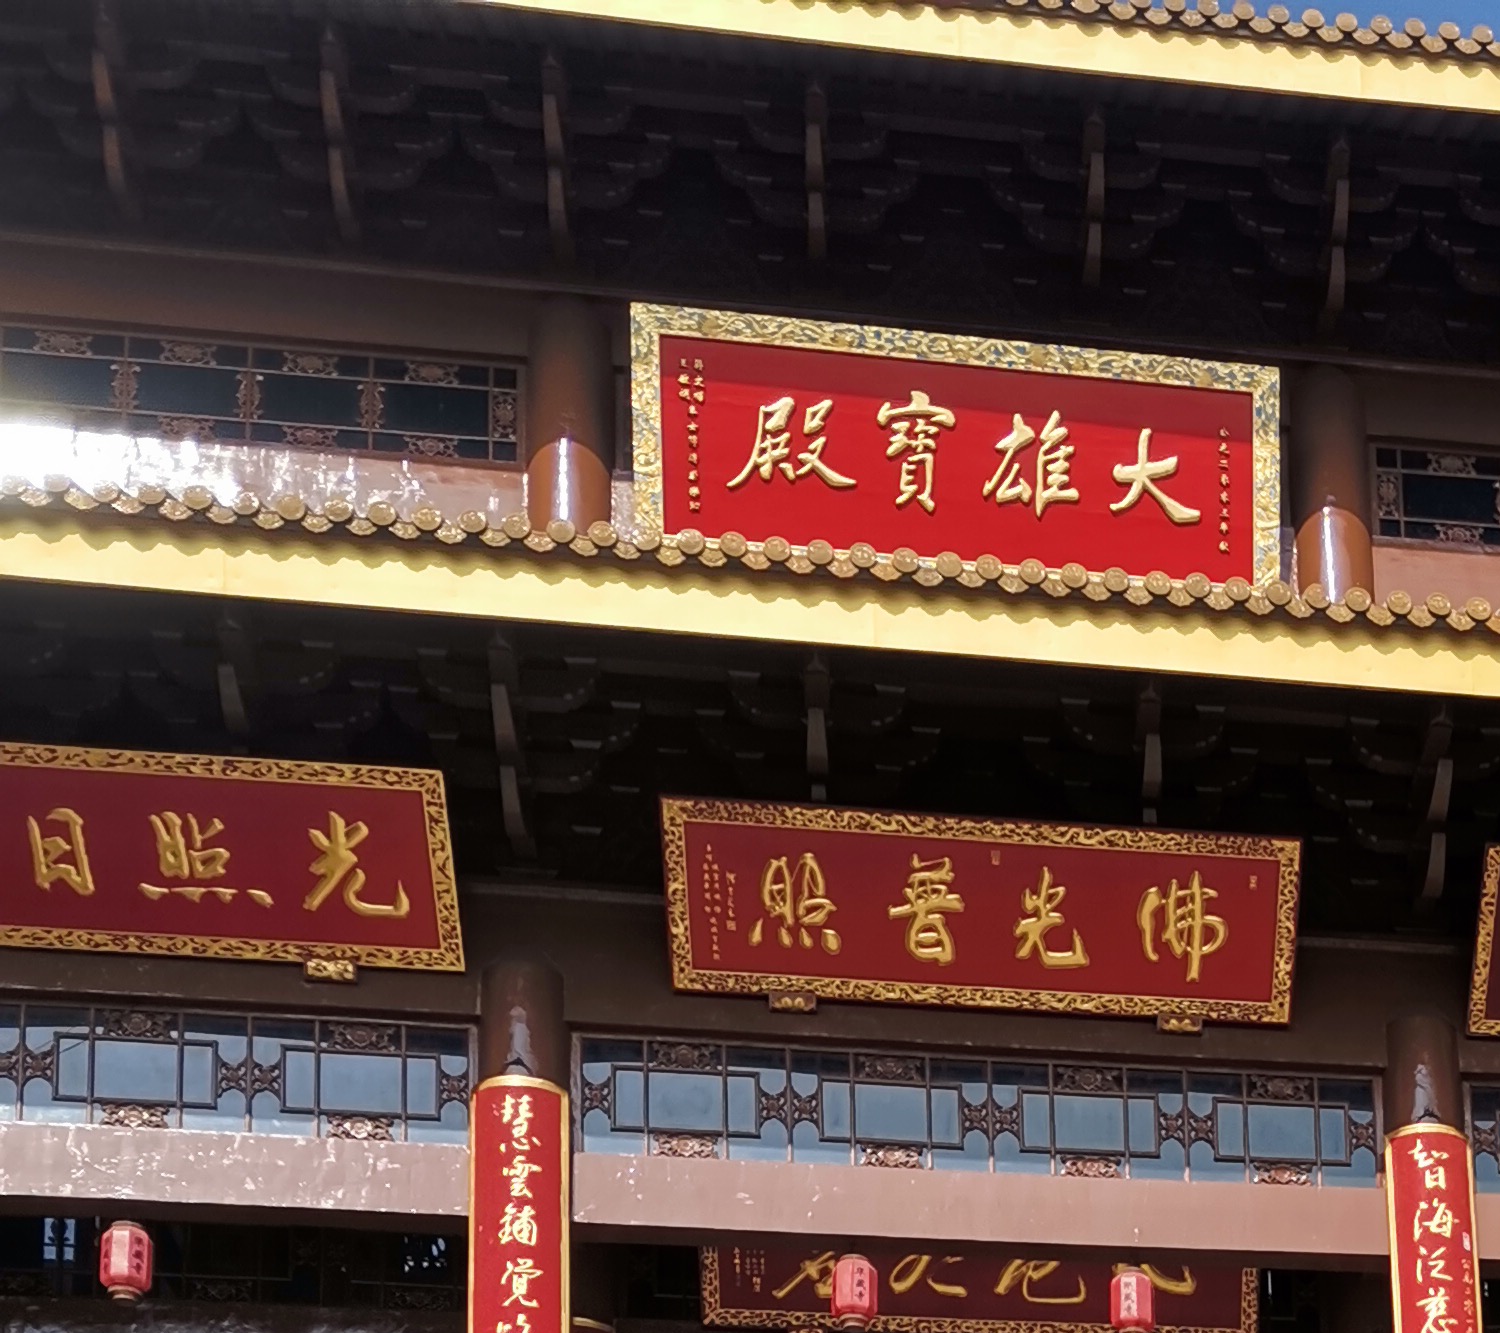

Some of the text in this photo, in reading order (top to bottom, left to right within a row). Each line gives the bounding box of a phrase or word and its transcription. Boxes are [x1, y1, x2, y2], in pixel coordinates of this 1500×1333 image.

[727, 391, 1202, 525] 大雄寶殿
[747, 852, 1229, 983] 佛光普照
